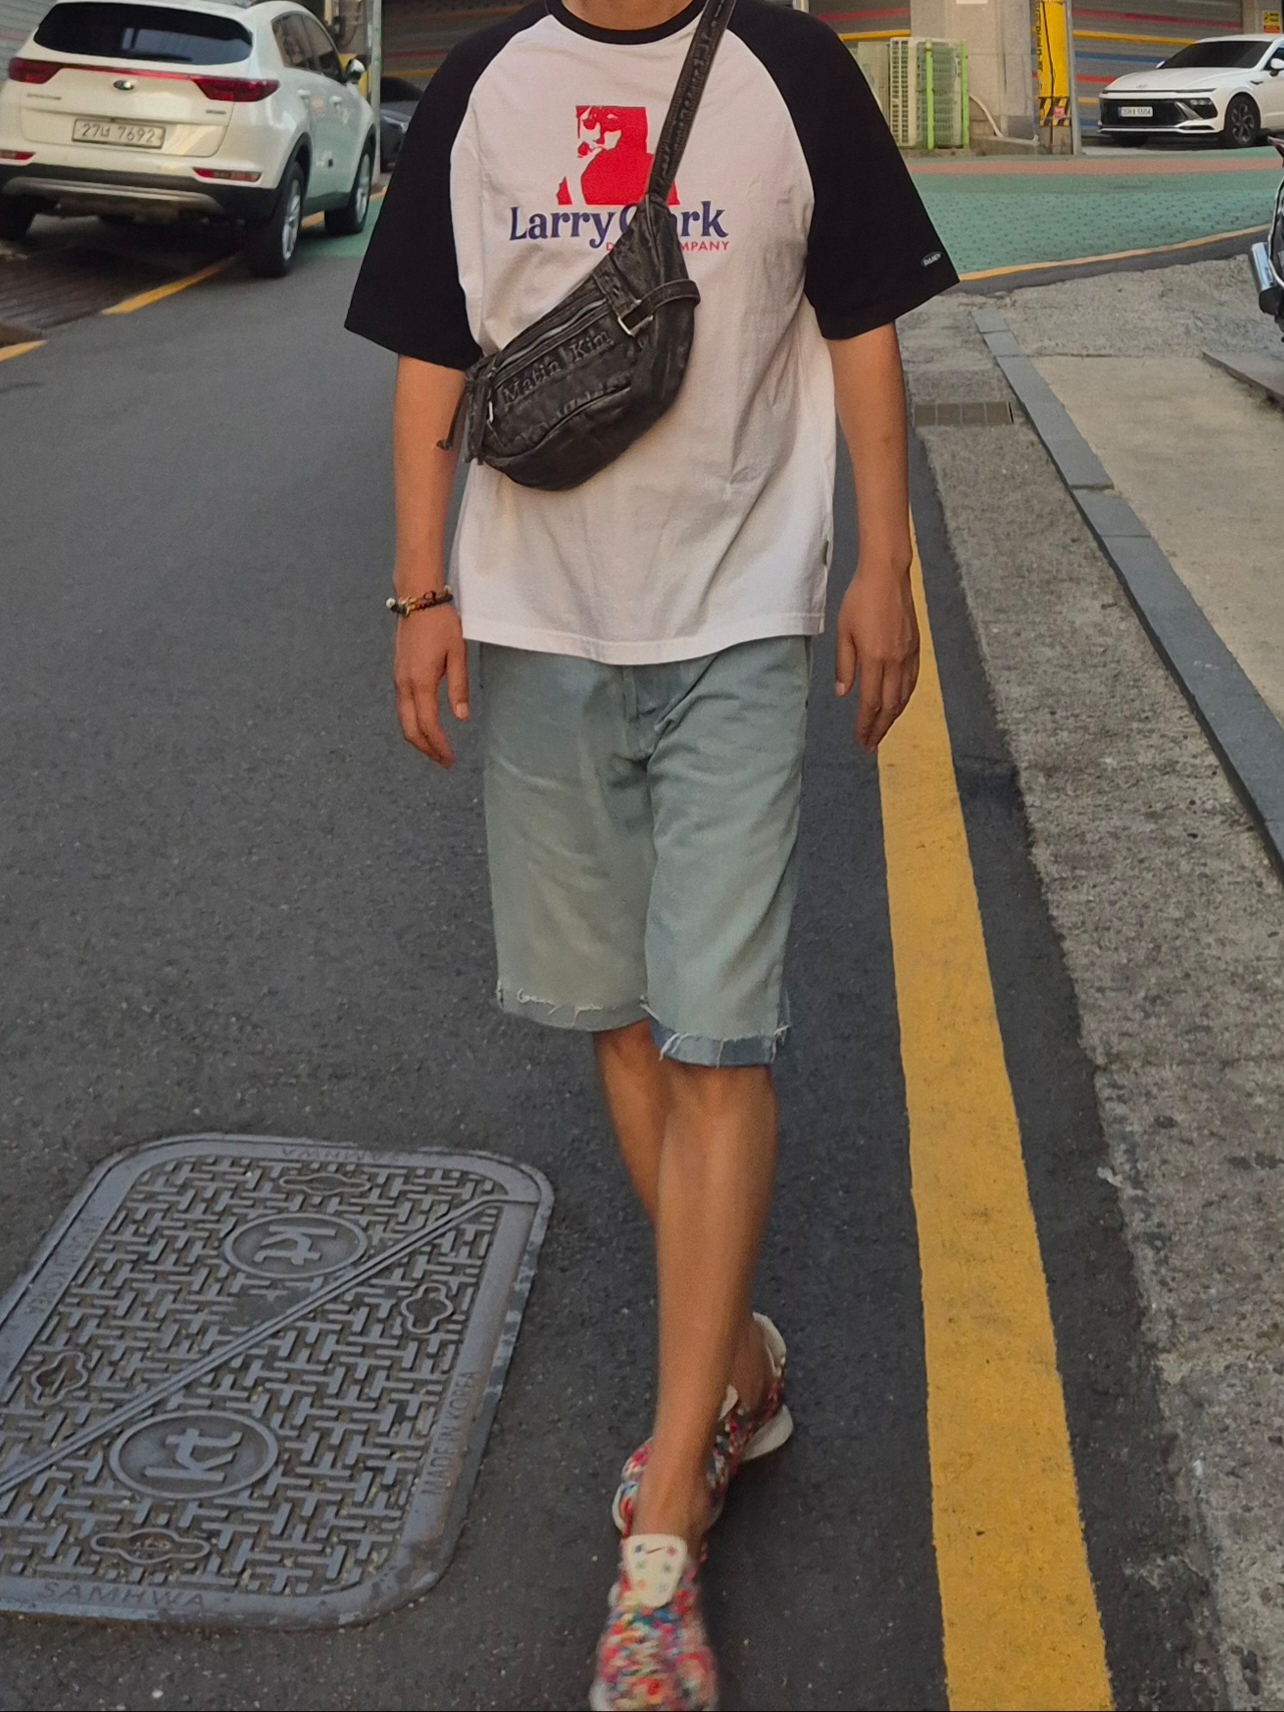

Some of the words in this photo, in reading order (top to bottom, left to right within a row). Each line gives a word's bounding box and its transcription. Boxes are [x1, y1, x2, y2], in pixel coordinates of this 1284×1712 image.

[117, 125, 155, 144] 7692
[509, 206, 616, 249] Larry
[619, 201, 729, 238] Crk
[681, 241, 730, 252] MPANY
[502, 360, 562, 408] Matin
[570, 330, 615, 363] Kim
[38, 1581, 205, 1607] SAMHWA
